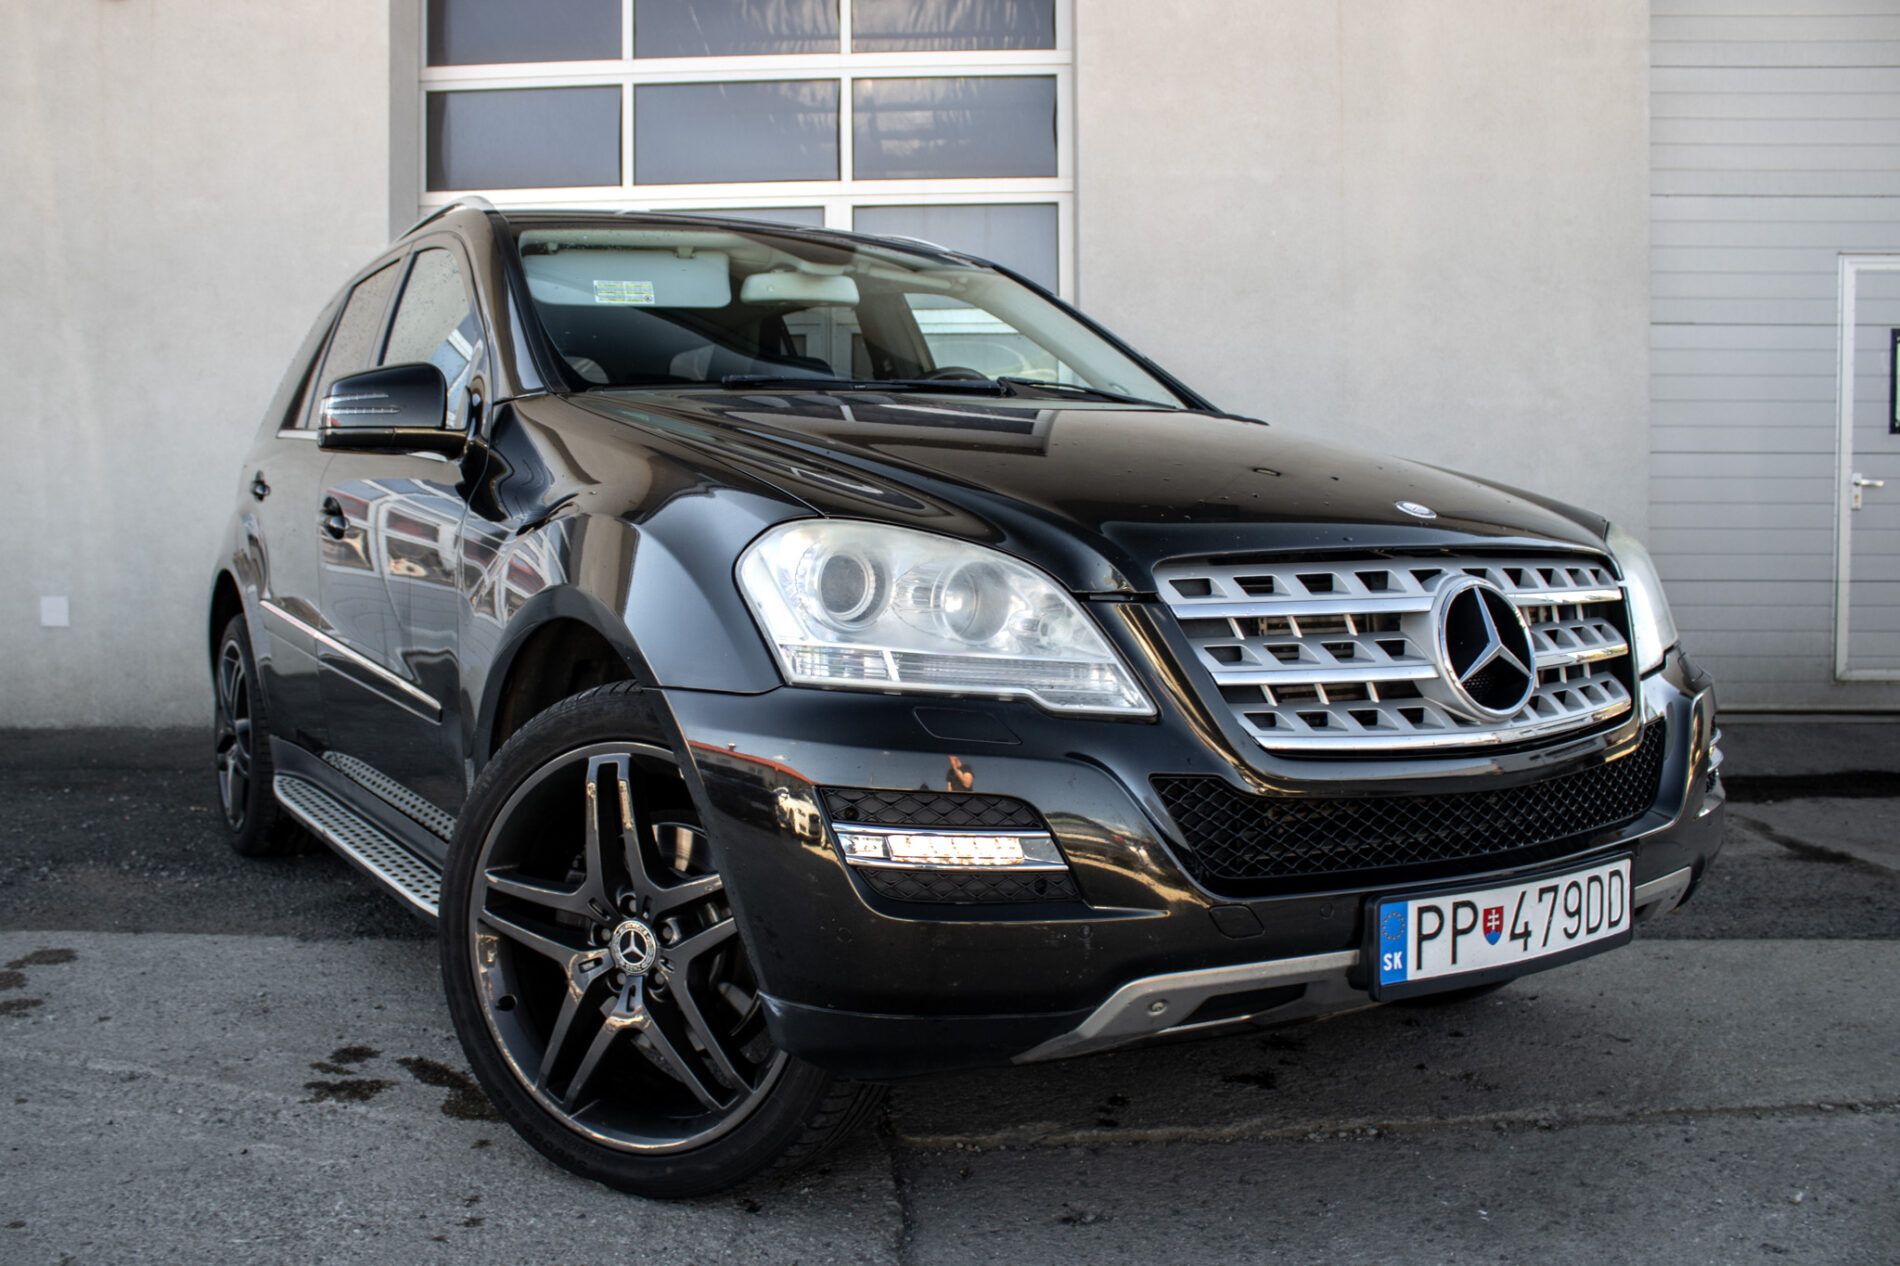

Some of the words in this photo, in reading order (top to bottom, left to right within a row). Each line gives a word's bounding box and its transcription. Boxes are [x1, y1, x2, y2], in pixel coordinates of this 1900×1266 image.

[1416, 900, 1478, 970] PP
[1509, 869, 1624, 952] 479DD
[1383, 951, 1403, 971] SK
